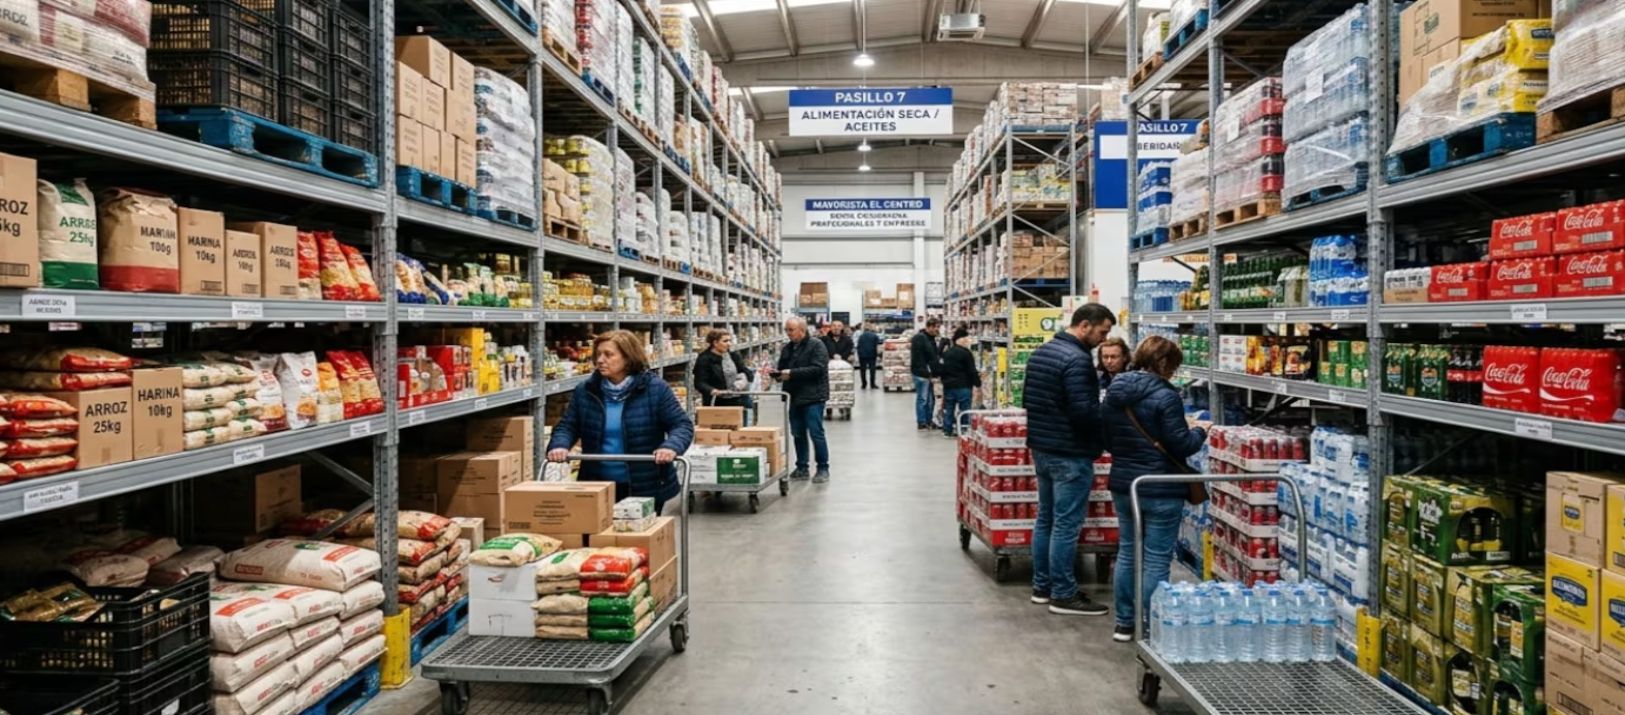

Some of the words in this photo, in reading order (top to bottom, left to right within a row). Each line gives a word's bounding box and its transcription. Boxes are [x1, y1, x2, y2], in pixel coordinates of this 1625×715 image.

[835, 92, 894, 103] PASILLO
[897, 91, 906, 103] 7
[801, 108, 895, 120] ALIMENTACIÓN
[898, 109, 930, 119] SECA
[844, 121, 897, 131] ACEITES
[1137, 123, 1178, 132] ASILLO
[1180, 123, 1188, 132] 7
[812, 200, 868, 209] MAYORISTA
[869, 200, 882, 209] EL
[138, 386, 180, 401] HARINA
[85, 401, 128, 417] ARROZ
[148, 404, 172, 418] 10kg
[93, 419, 122, 434] 25kg
